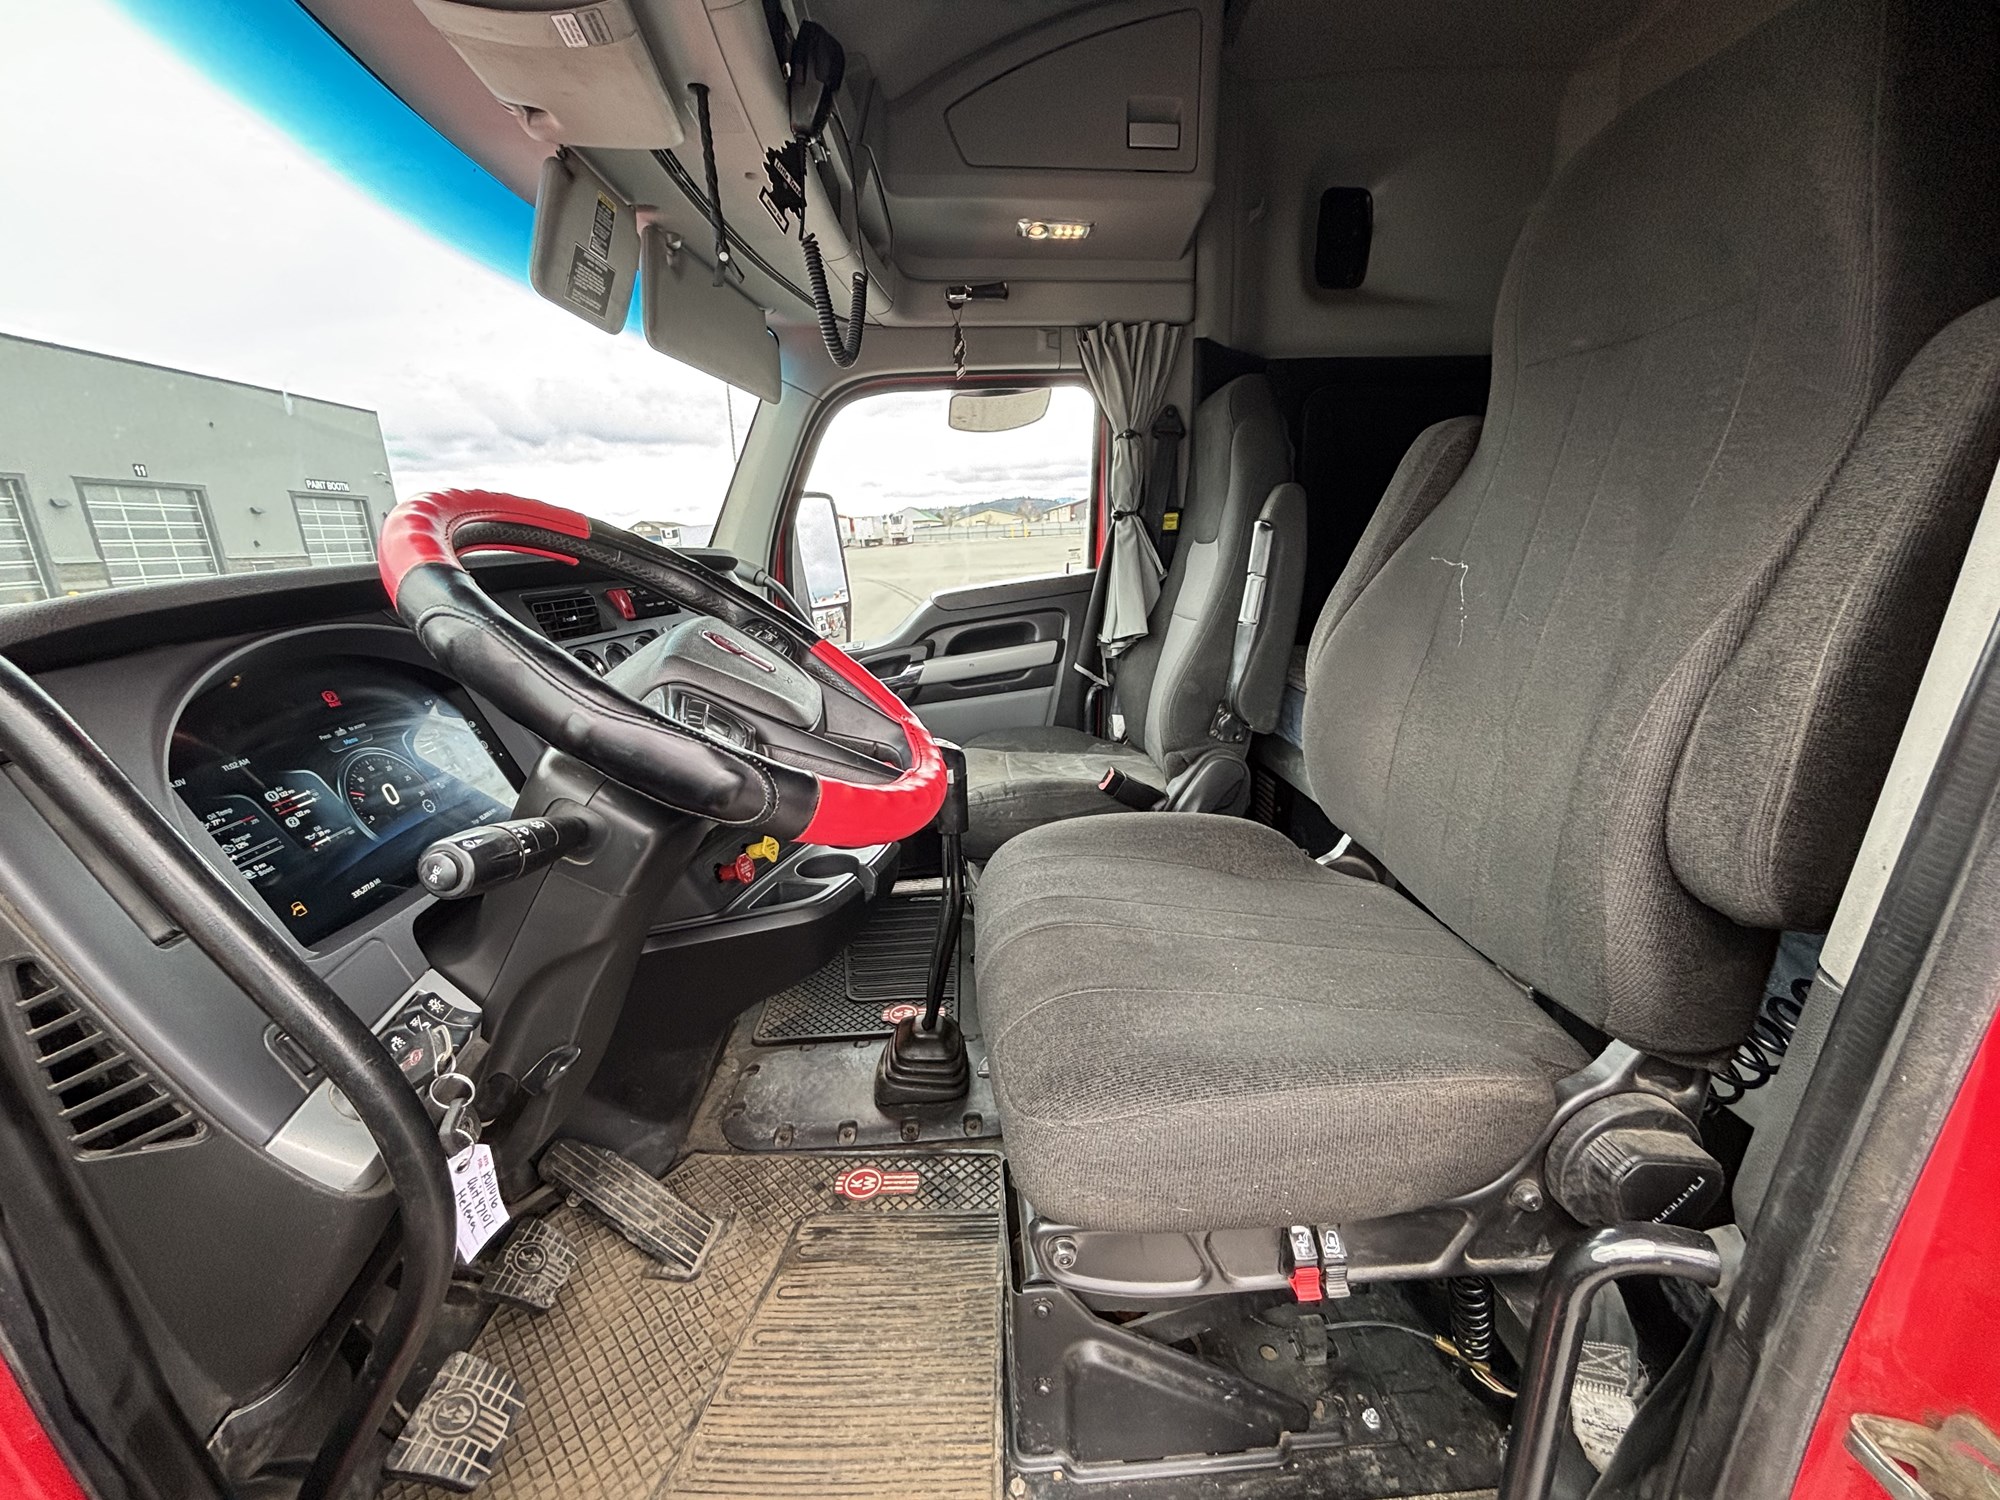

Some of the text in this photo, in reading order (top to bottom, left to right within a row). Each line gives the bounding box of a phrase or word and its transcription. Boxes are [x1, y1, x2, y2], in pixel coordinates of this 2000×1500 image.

[134, 465, 146, 476] 11
[305, 479, 350, 491] PAINT BOOTH
[221, 757, 252, 772] 11:02 AM
[381, 783, 400, 806] 0
[215, 807, 233, 817] Temp
[455, 1187, 477, 1234] Helena
[474, 1196, 495, 1229] 47101
